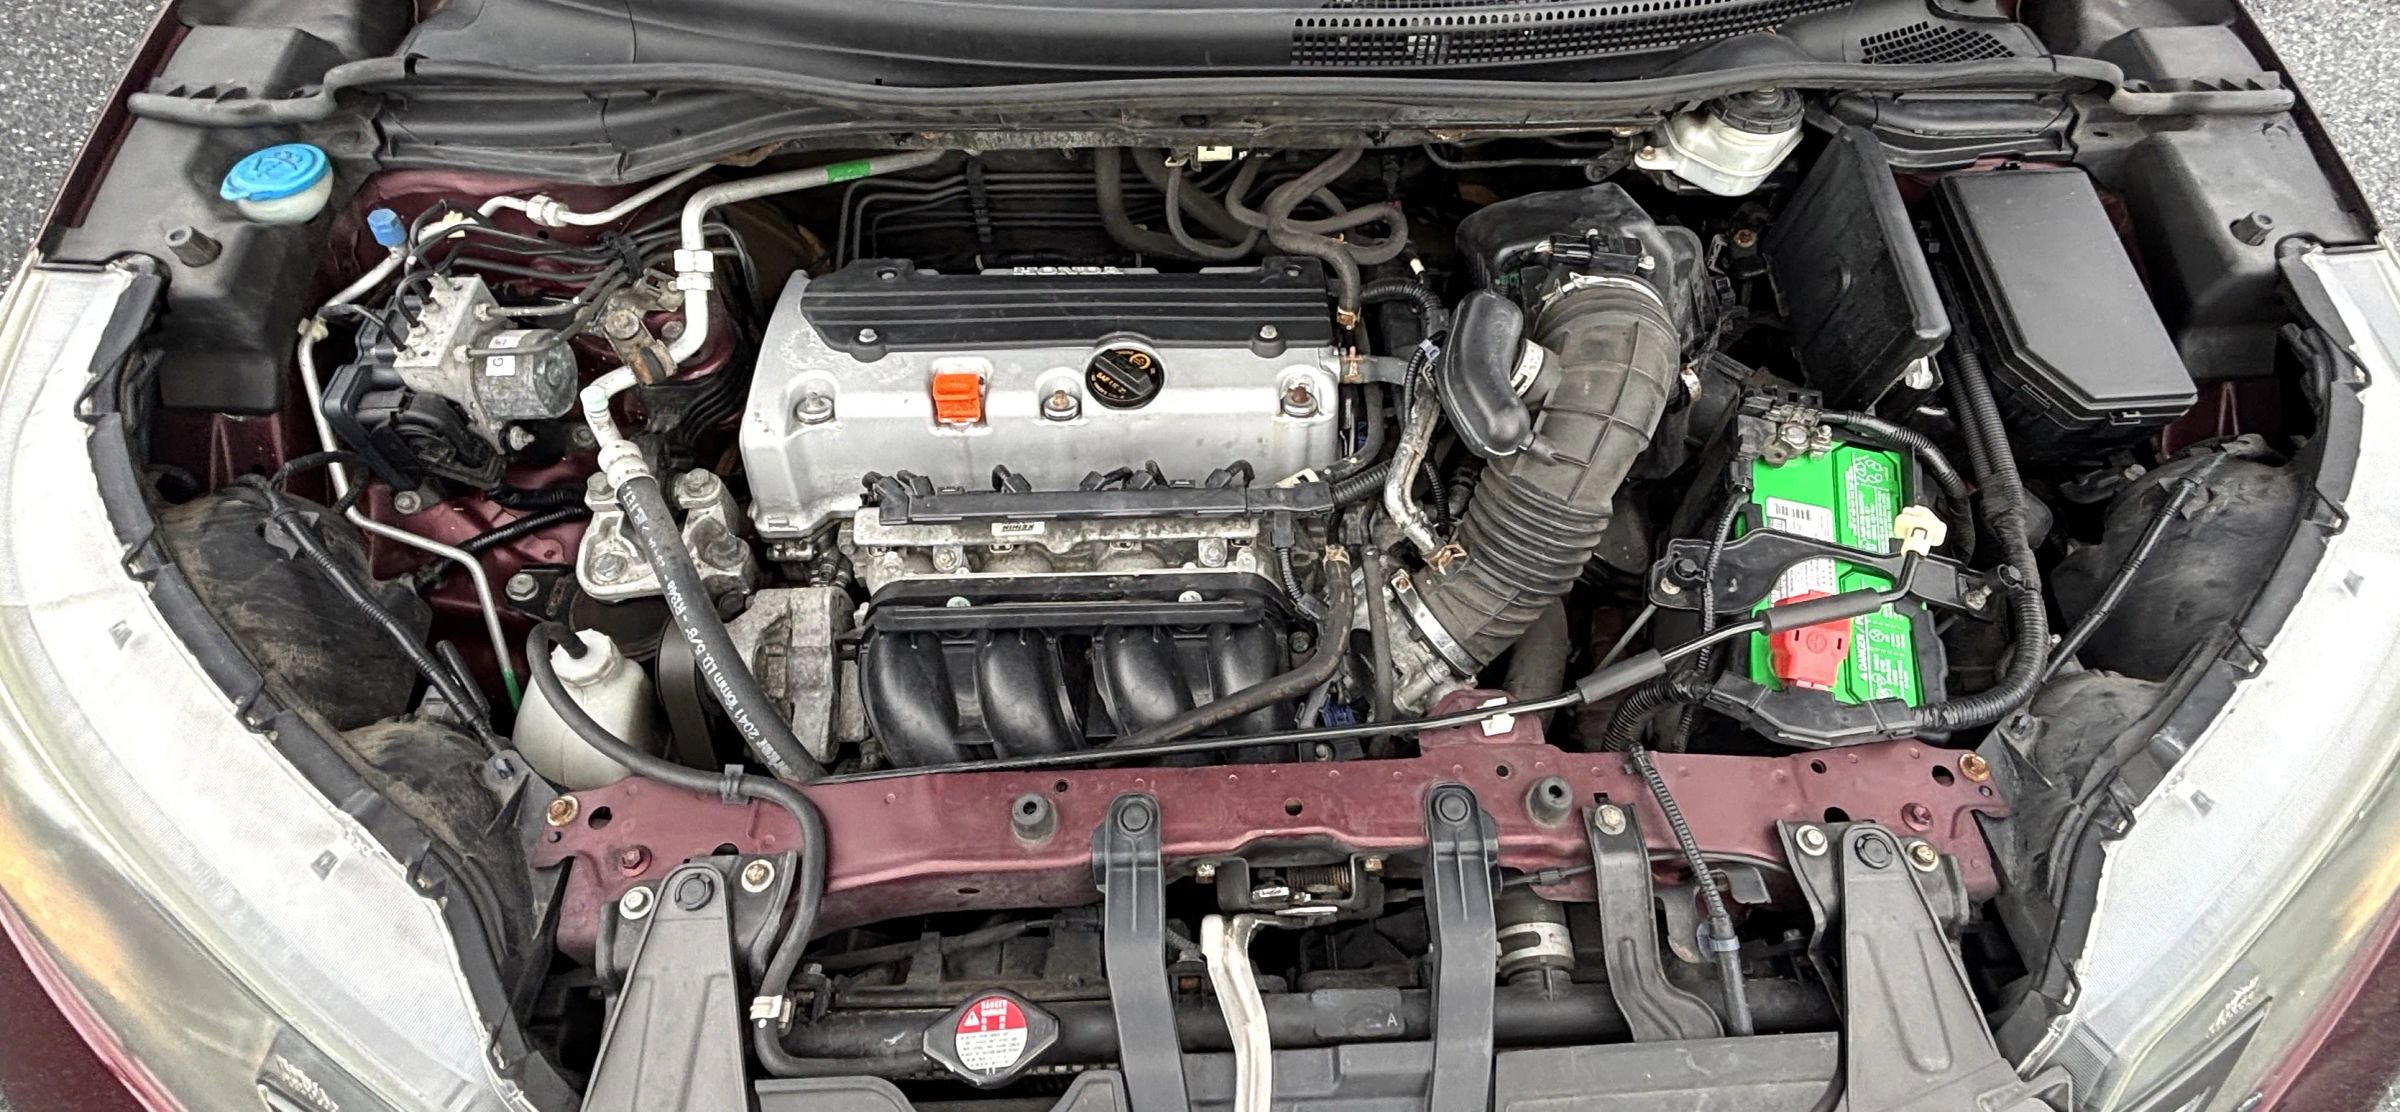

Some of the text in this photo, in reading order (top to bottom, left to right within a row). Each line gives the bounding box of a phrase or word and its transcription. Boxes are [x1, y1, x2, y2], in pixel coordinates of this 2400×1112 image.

[1013, 266, 1124, 276] HONDA
[667, 580, 688, 617] R134a
[1855, 633, 1868, 672] DANGER
[713, 671, 739, 711] 16mm
[734, 708, 760, 739] 2041
[1386, 1011, 1398, 1027] A
